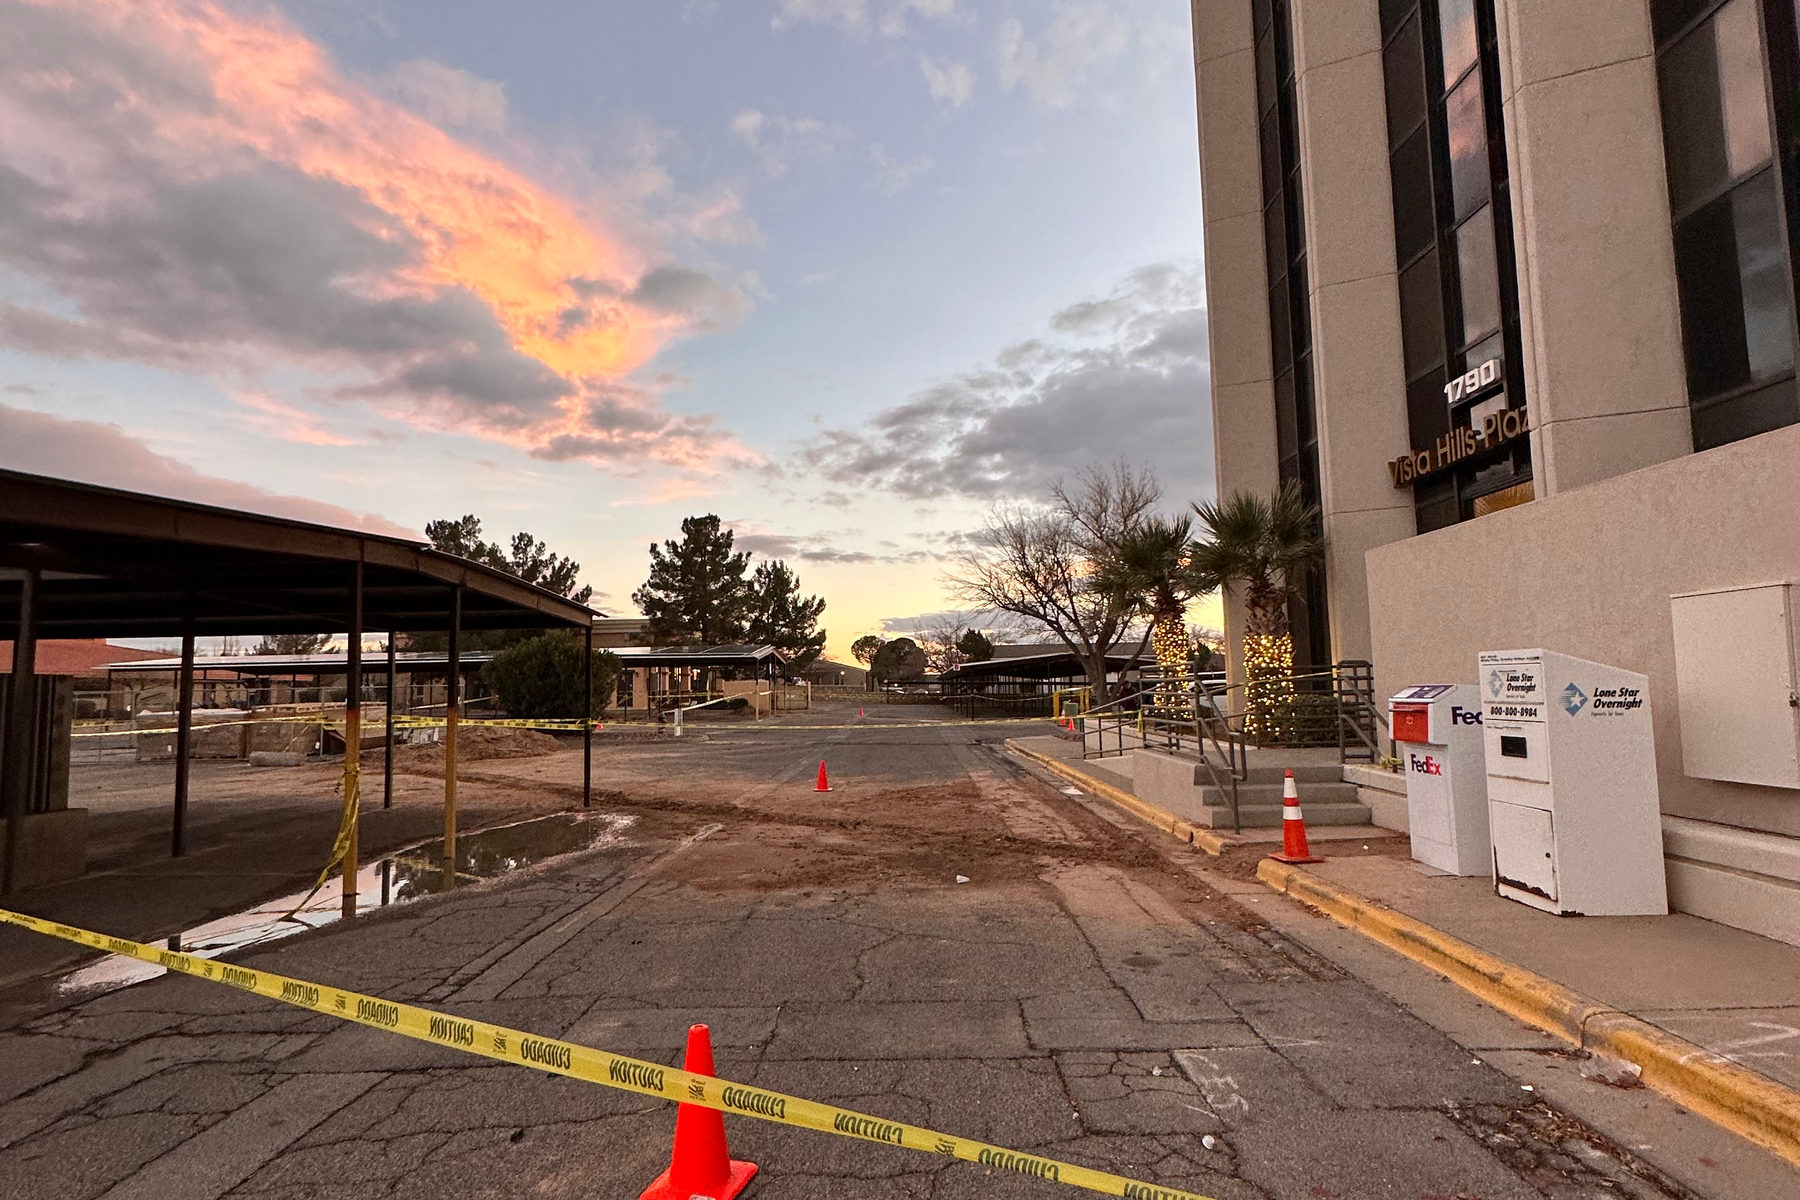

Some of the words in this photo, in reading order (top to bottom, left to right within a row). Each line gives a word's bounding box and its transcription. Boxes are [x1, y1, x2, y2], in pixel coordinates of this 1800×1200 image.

[1444, 359, 1498, 403] 1790
[1388, 449, 1431, 488] Vista
[1437, 426, 1476, 467] Hills
[1483, 405, 1529, 449] Plaz
[1506, 673, 1520, 682] Lone
[1521, 673, 1534, 682] Star
[1506, 683, 1537, 693] Overnight
[1593, 687, 1618, 698] Lone
[1618, 687, 1640, 697] Star
[1593, 698, 1642, 710] Overnight
[1490, 706, 1537, 717] 800-800-8984
[1411, 754, 1442, 776] FedEx
